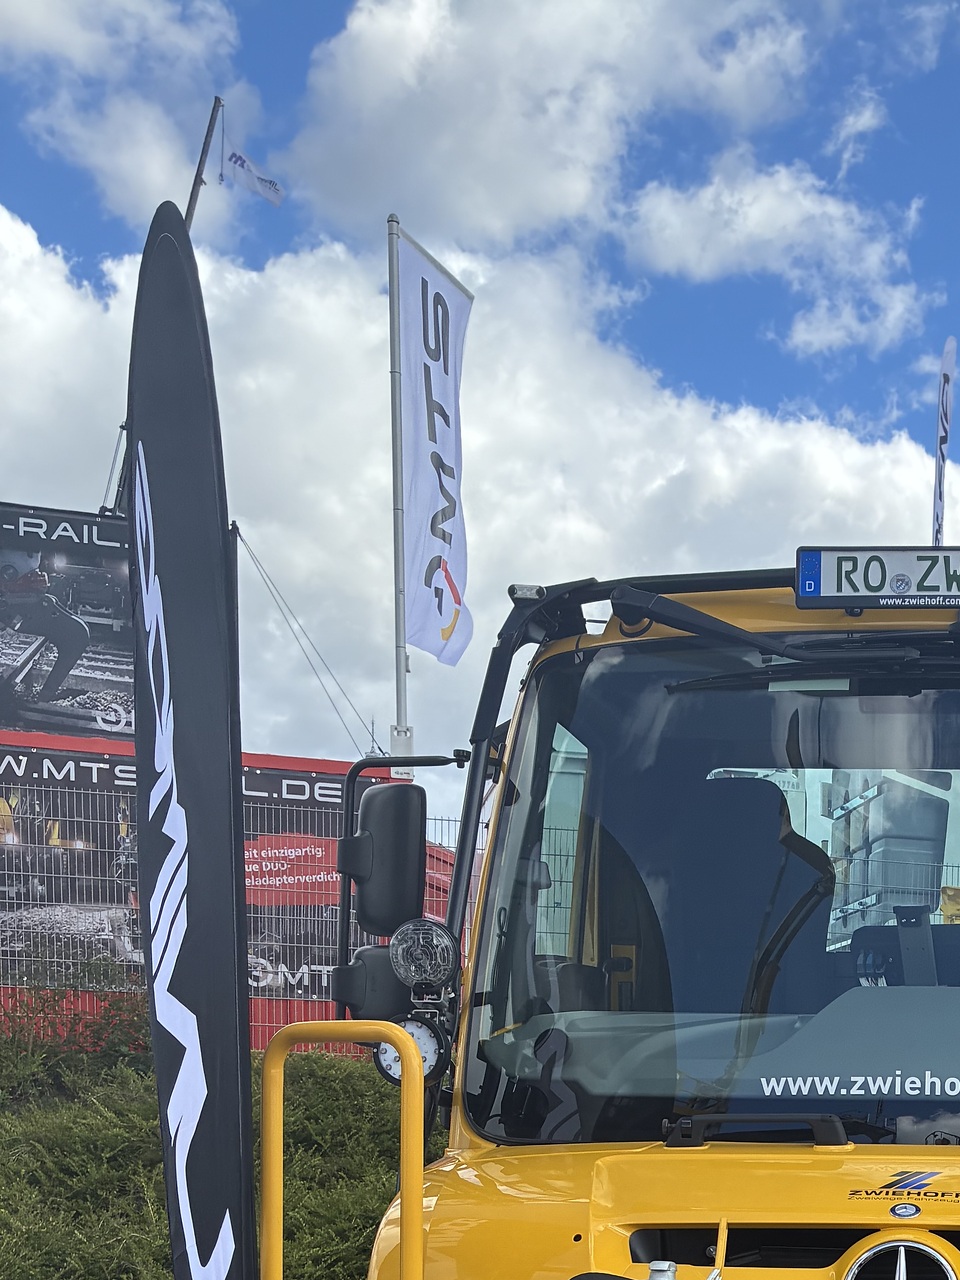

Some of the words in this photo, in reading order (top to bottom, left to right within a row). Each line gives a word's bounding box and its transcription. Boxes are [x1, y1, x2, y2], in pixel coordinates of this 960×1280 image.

[836, 555, 888, 593] RO
[805, 580, 815, 592] D
[245, 872, 342, 887] eladapterverdich
